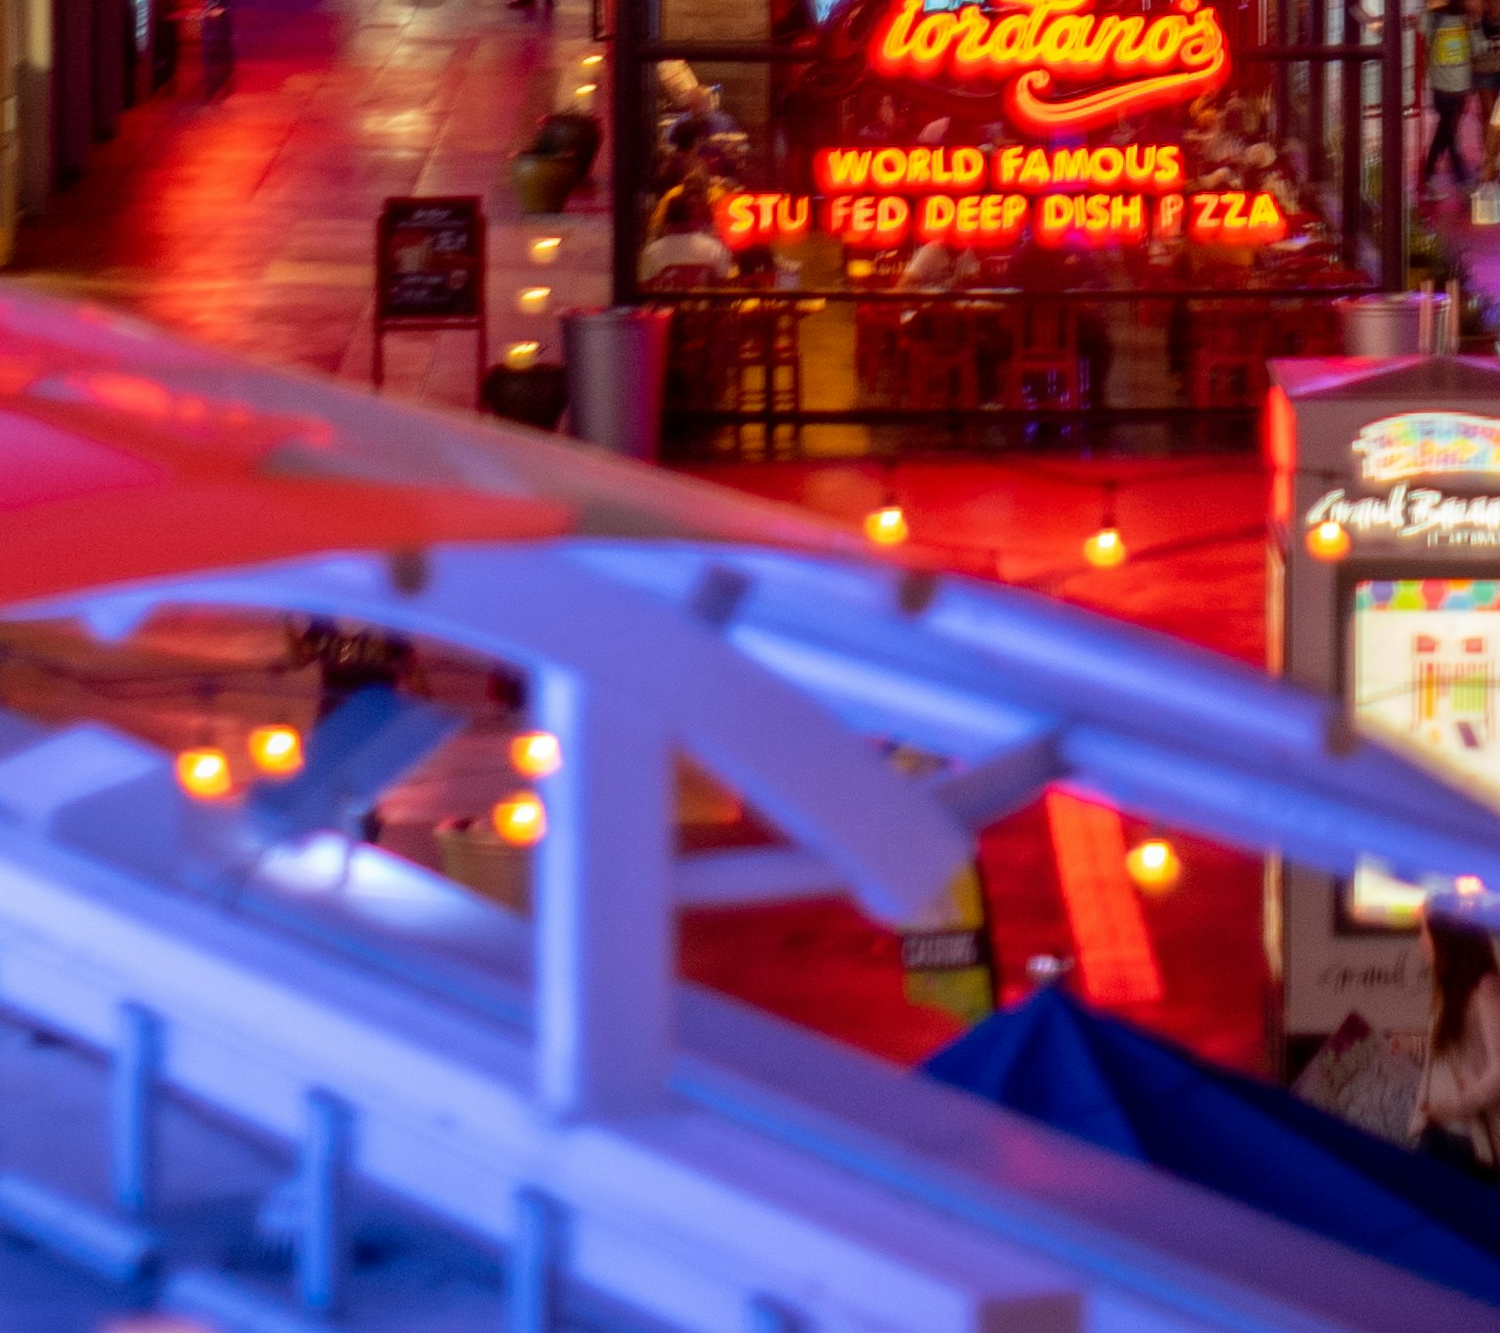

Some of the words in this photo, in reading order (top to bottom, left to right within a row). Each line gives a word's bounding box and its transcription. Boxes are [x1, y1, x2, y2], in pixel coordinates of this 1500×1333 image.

[829, 147, 984, 184] WORLD
[1002, 144, 1181, 183] FAMOUS
[925, 194, 1027, 230] DEEP
[1043, 192, 1142, 230] DISH
